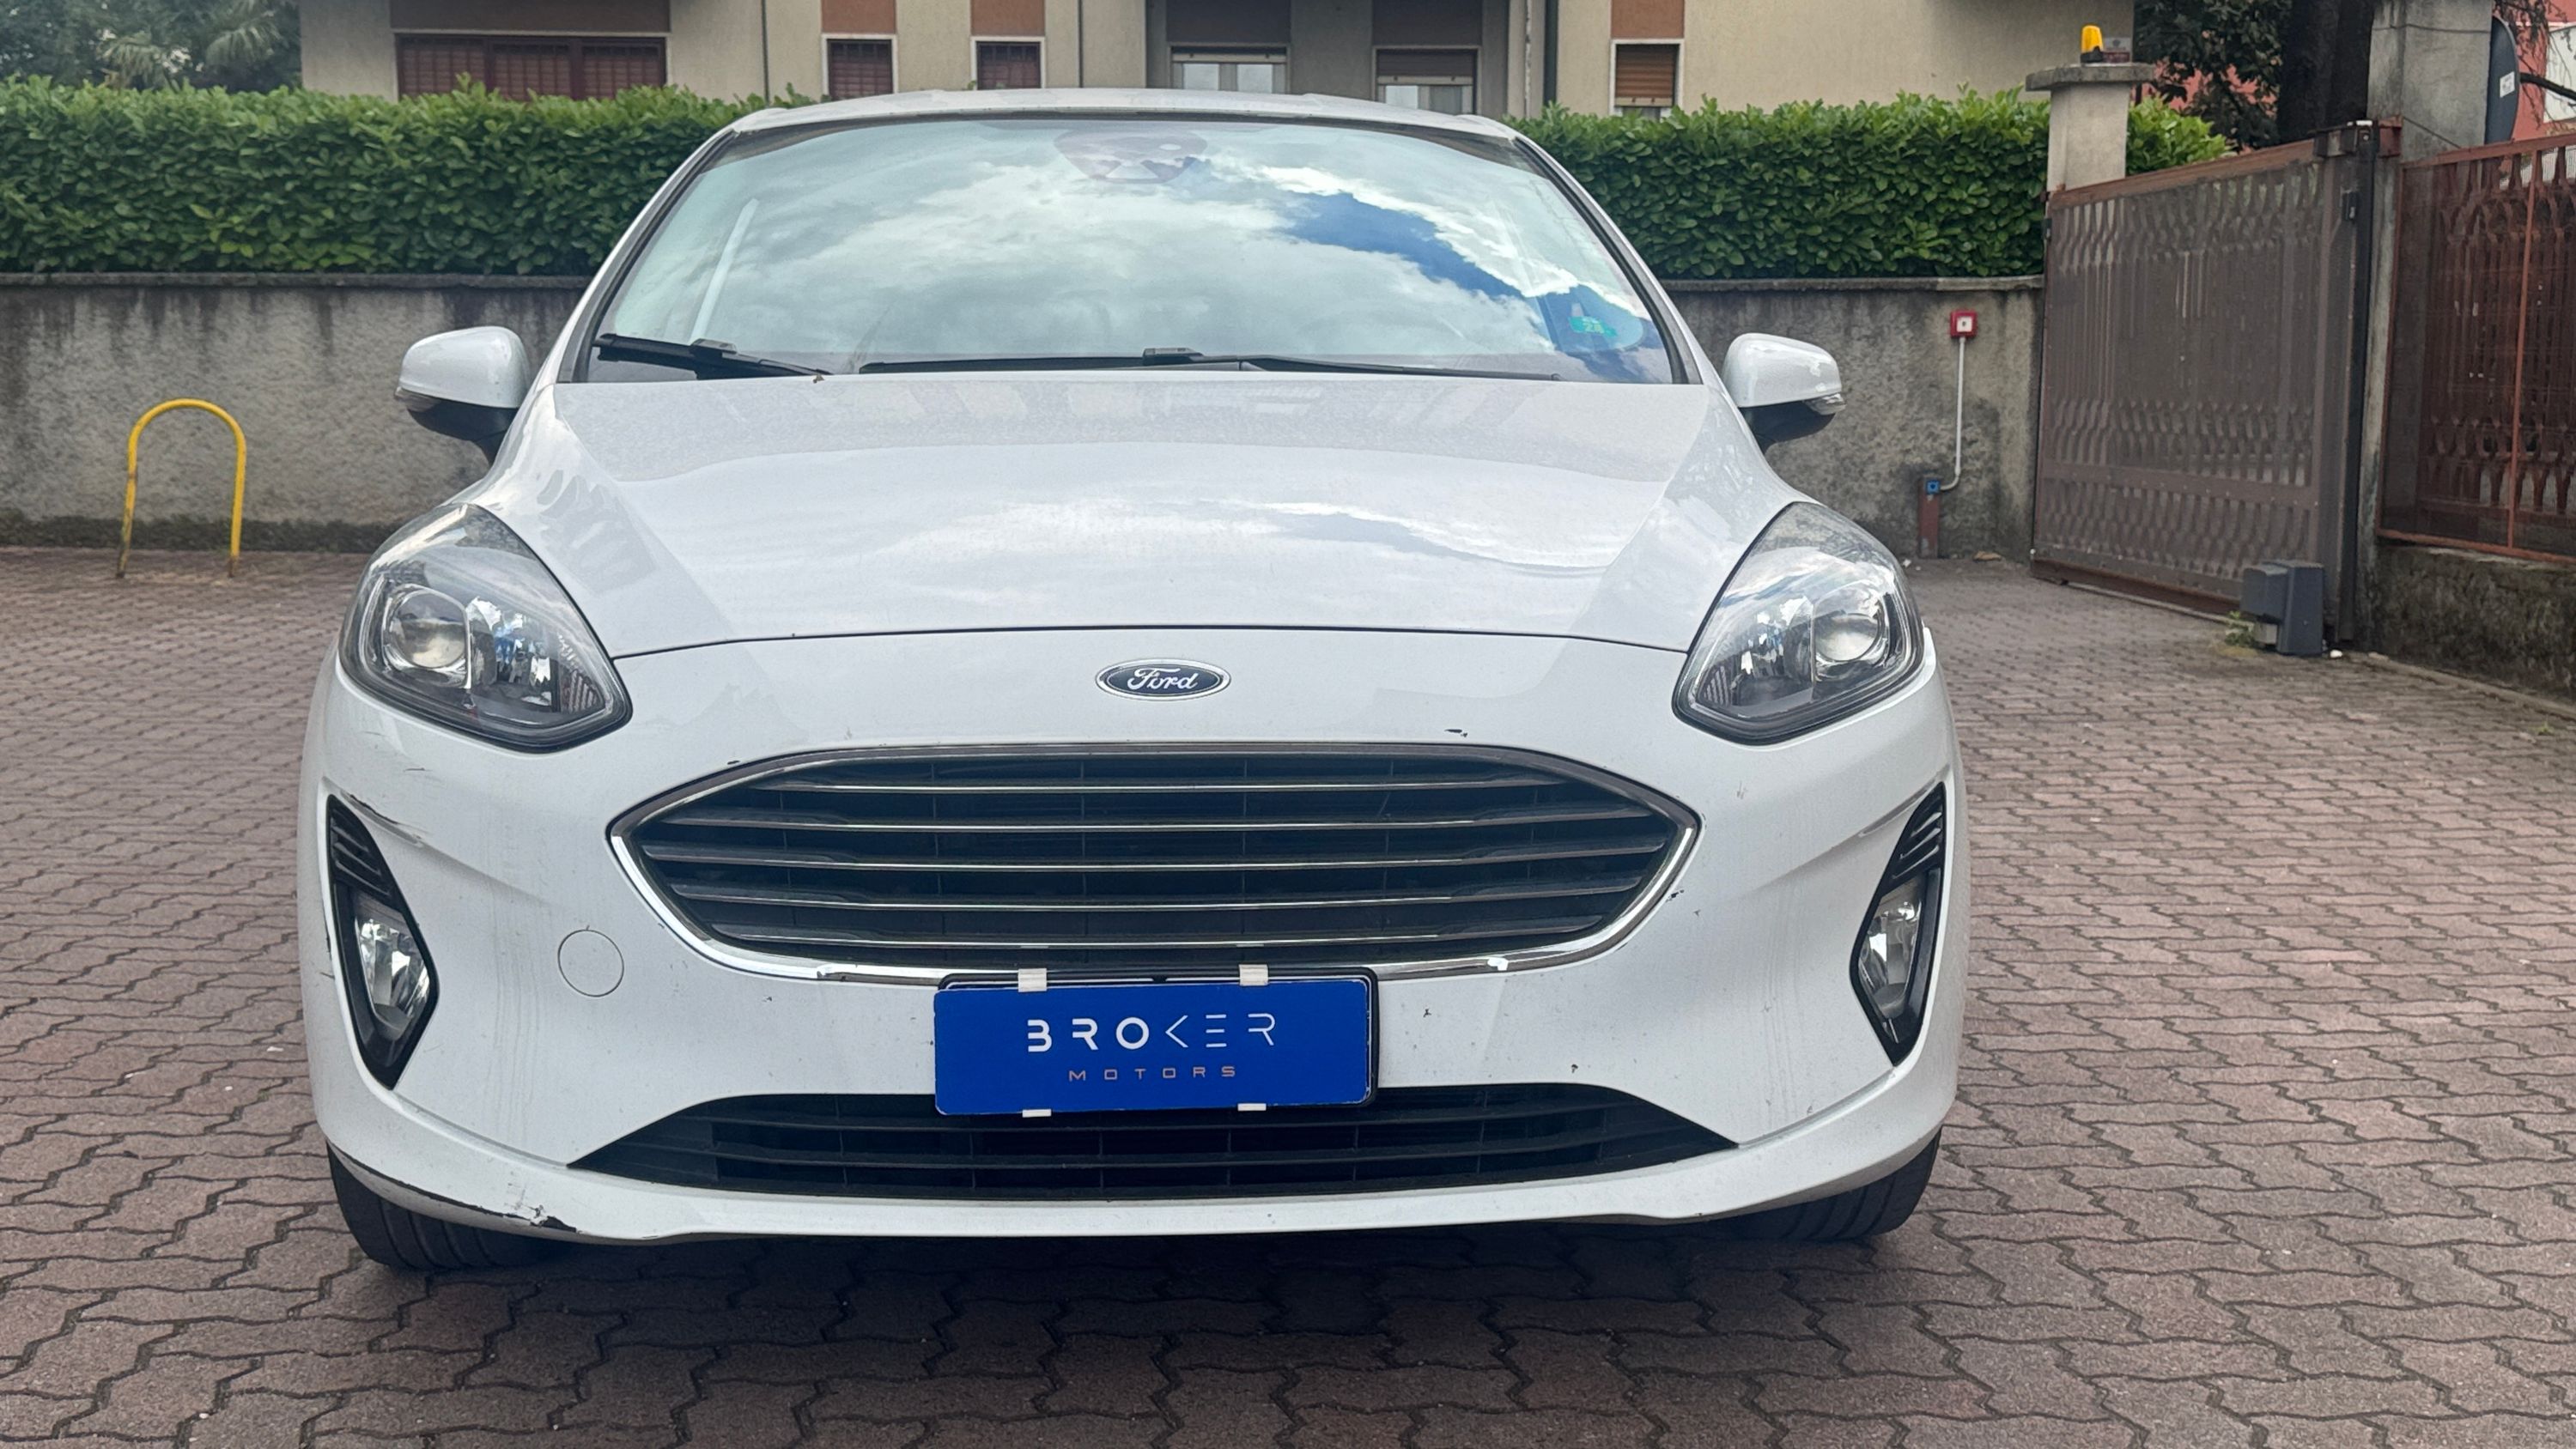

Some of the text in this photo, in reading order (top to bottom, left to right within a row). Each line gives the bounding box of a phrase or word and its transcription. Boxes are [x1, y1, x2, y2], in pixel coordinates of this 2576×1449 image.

[1127, 667, 1200, 690] Ford
[1027, 1013, 1276, 1052] BROKER
[1068, 1065, 1236, 1082] MOTORS
